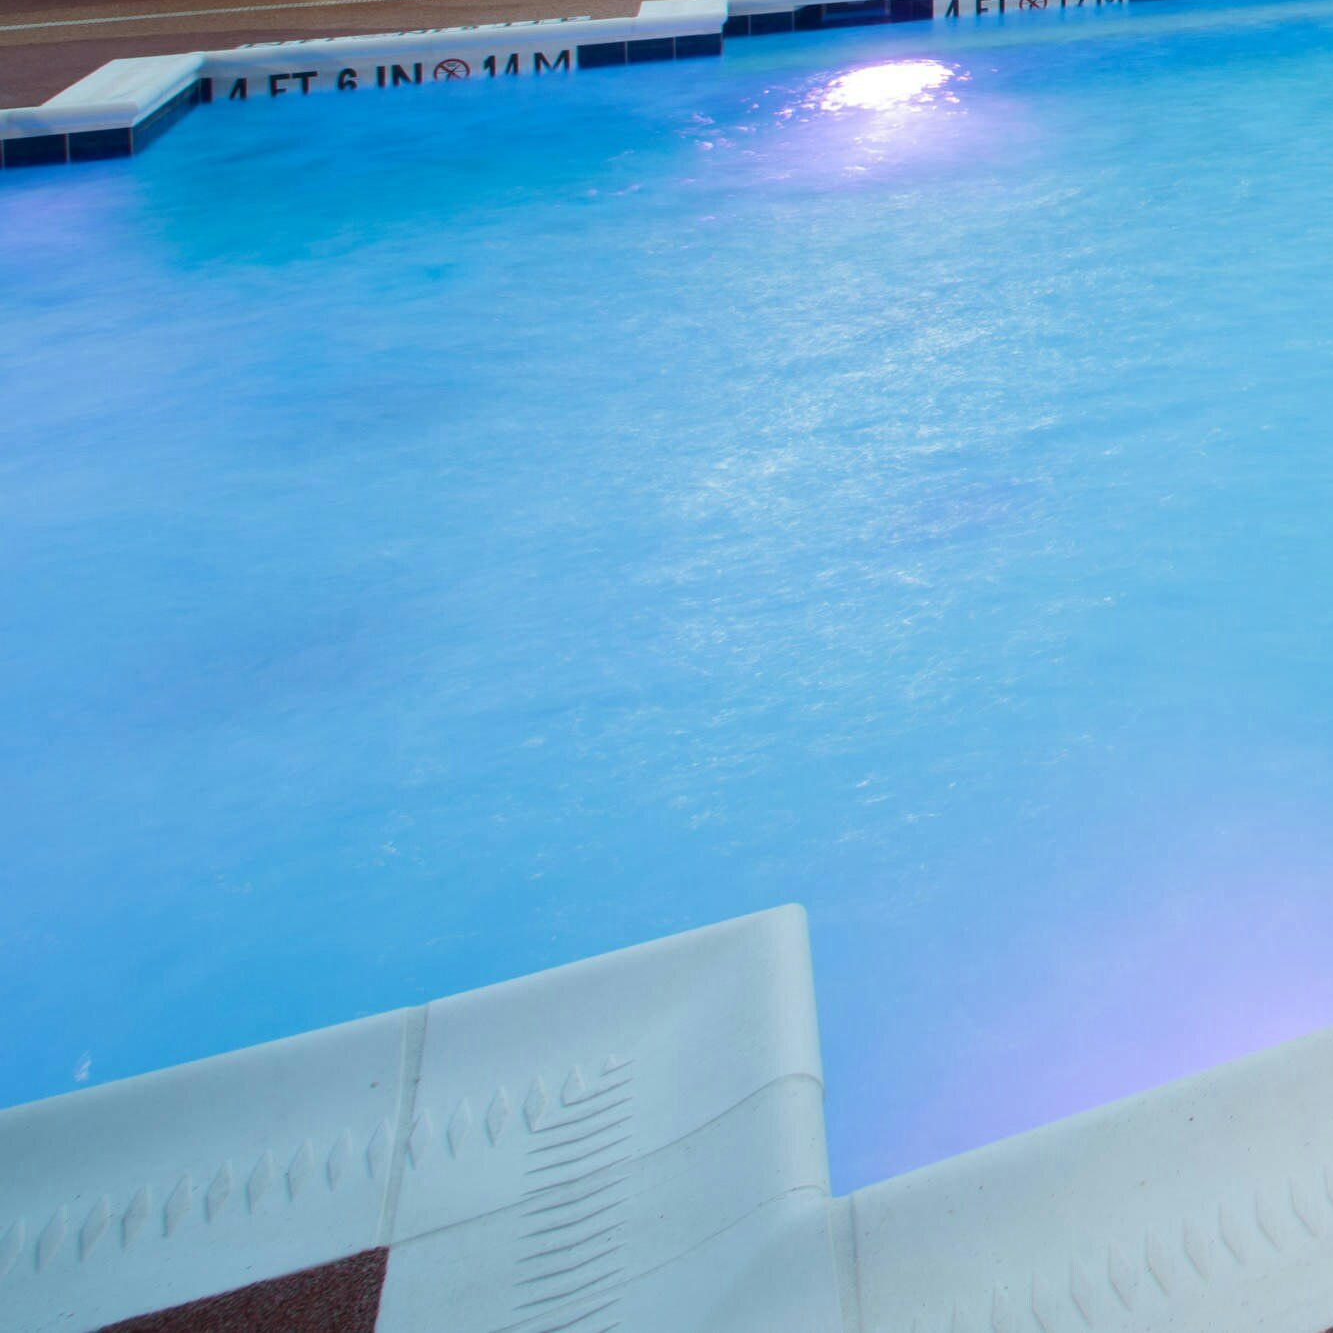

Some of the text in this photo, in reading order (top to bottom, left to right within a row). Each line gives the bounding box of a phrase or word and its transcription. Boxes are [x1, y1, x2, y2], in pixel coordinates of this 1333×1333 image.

[269, 71, 318, 98] FT
[337, 67, 358, 91] 6
[377, 62, 423, 88] IN
